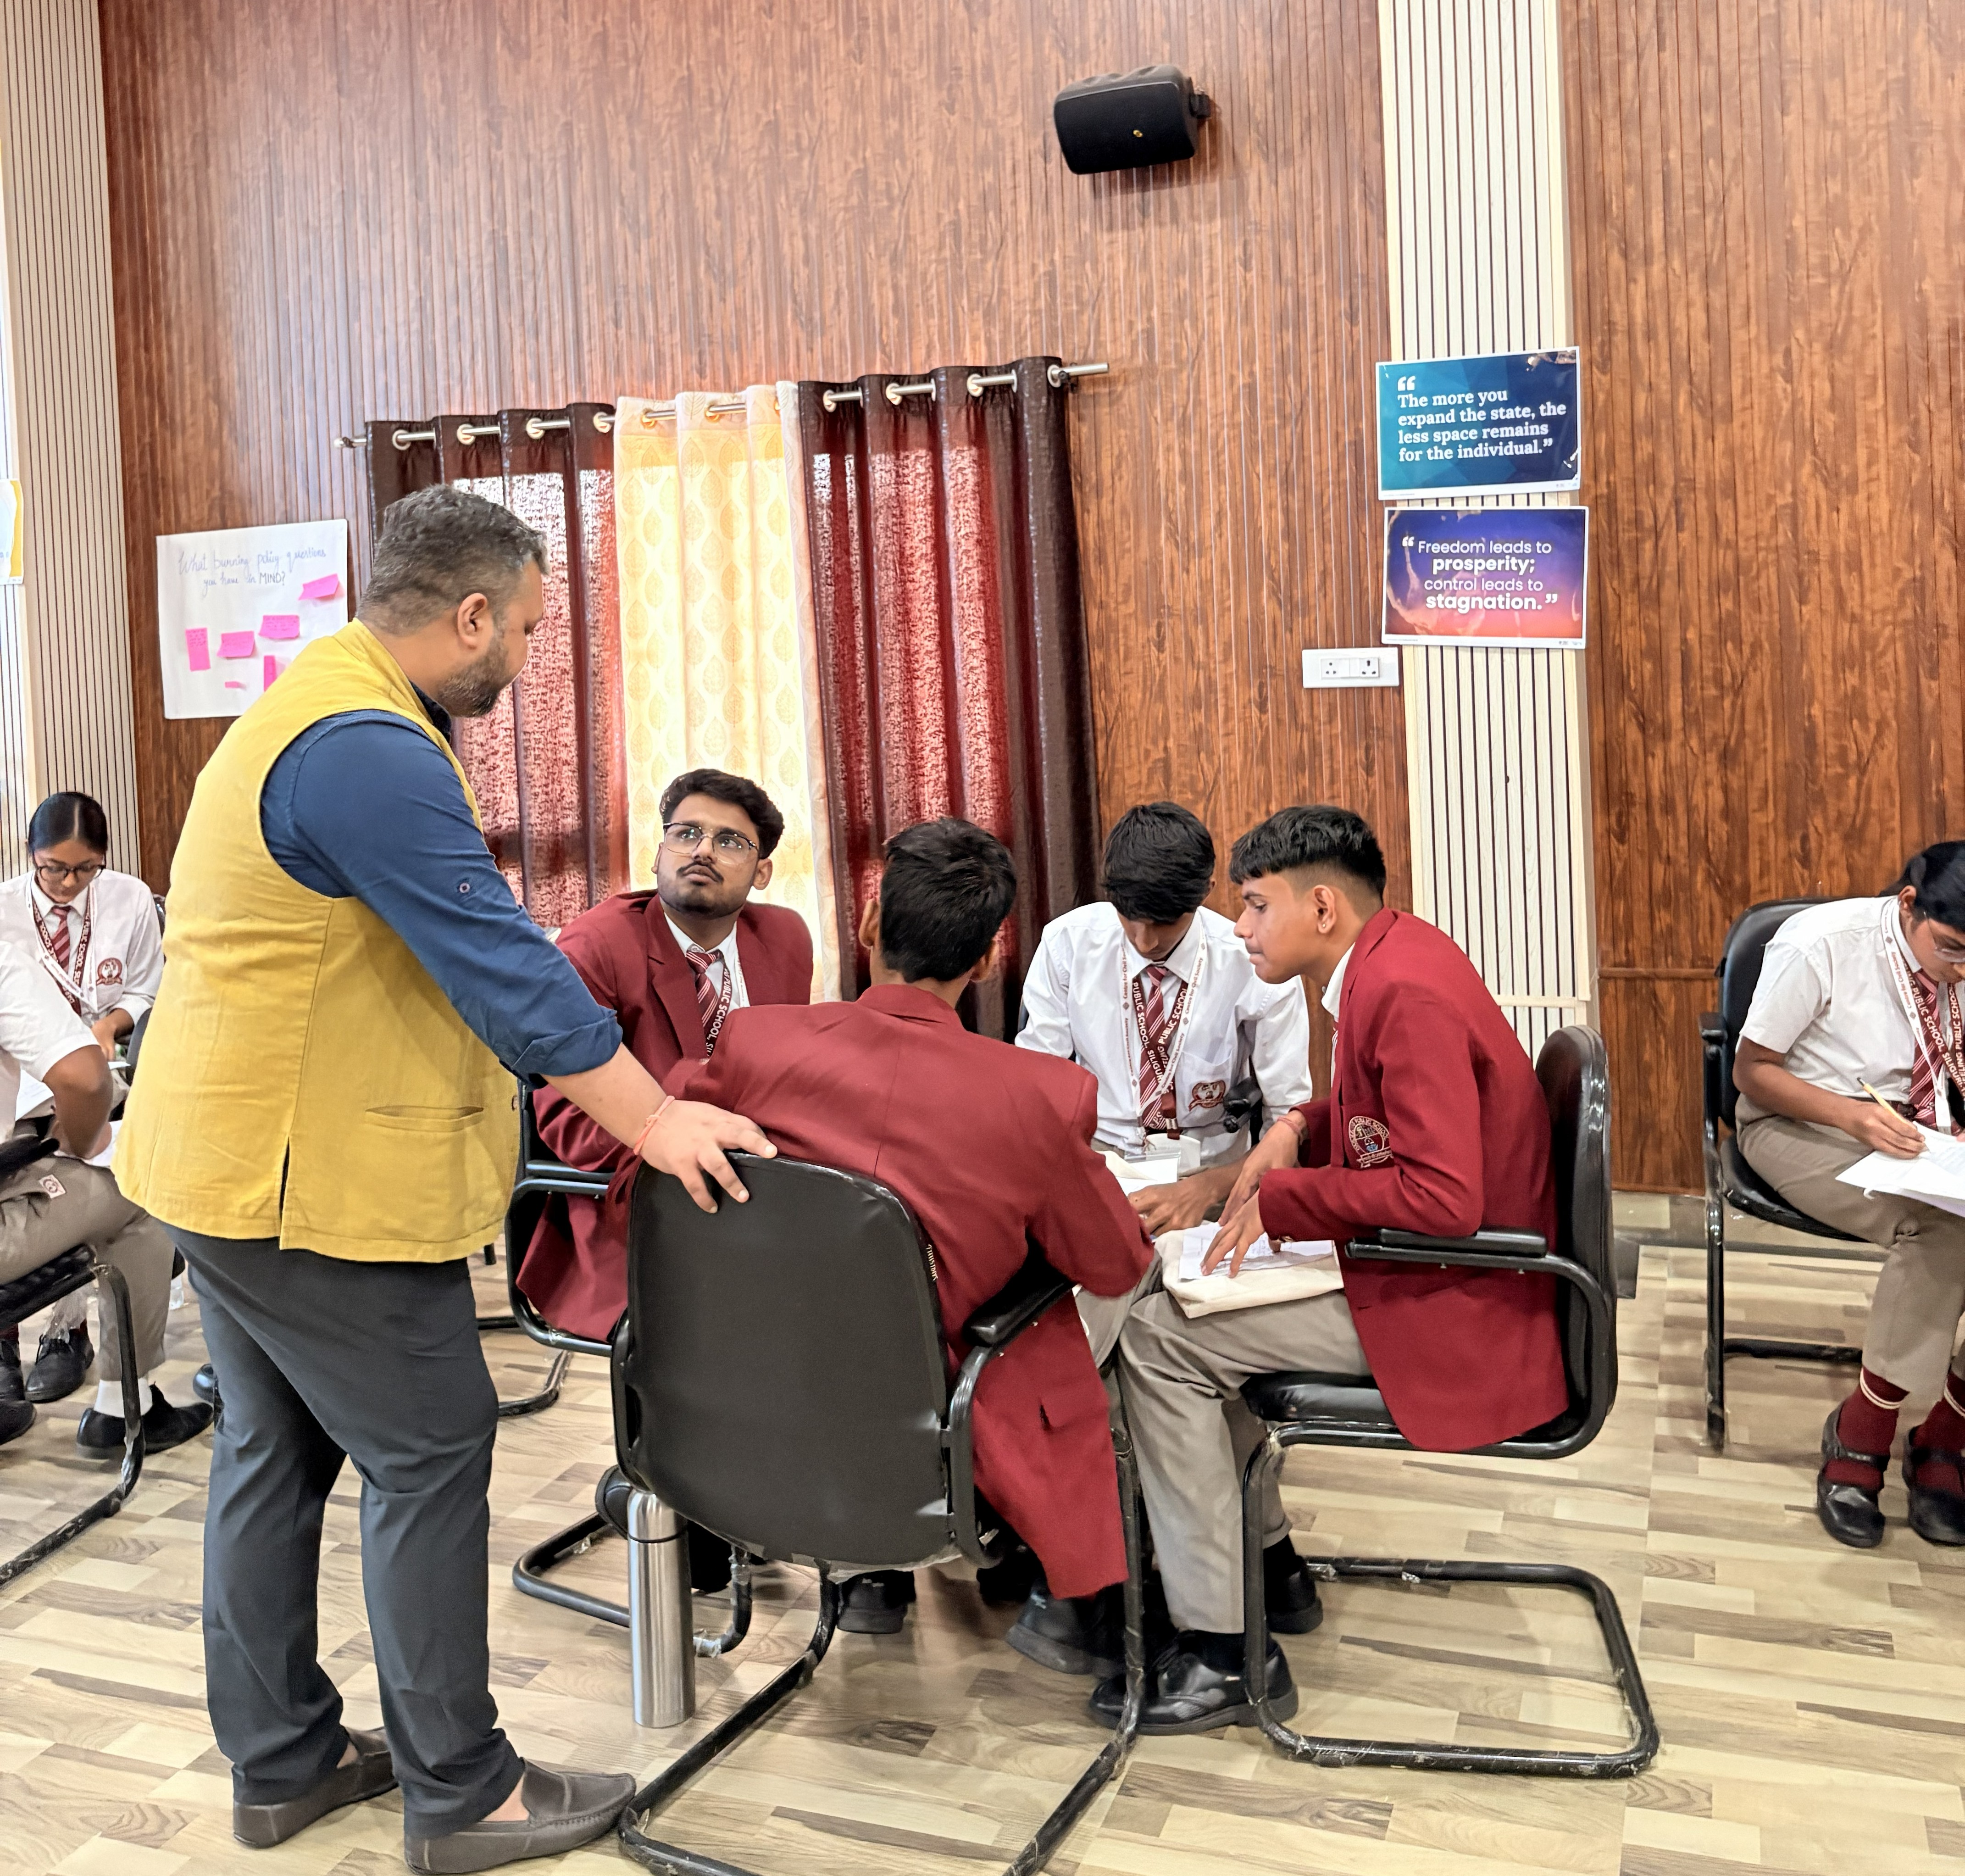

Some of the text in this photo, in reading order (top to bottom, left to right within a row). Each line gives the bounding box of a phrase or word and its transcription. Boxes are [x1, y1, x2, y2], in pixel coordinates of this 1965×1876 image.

[1398, 390, 1508, 408] The more you
[1398, 401, 1566, 429] expand the state, the
[1399, 422, 1549, 445] less space remains
[1399, 448, 1423, 462] for
[1427, 446, 1453, 461] the
[1490, 540, 1532, 554] leads
[1536, 541, 1552, 554] to
[178, 547, 326, 575] What burning policy questions
[1432, 556, 1535, 575] prosperity;
[202, 578, 216, 597] you
[246, 574, 257, 584] in
[259, 572, 286, 586] MIND?
[1424, 578, 1543, 591] control leads to
[1195, 957, 1203, 976] Society
[721, 976, 731, 1004] PUBLIC
[1132, 982, 1144, 1011] PUBLIC
[1912, 987, 1929, 1016] PUBLIC
[1158, 1019, 1177, 1044] PUBLIC
[1176, 1032, 1184, 1051] Society
[1953, 1020, 1963, 1050] PUBLIC
